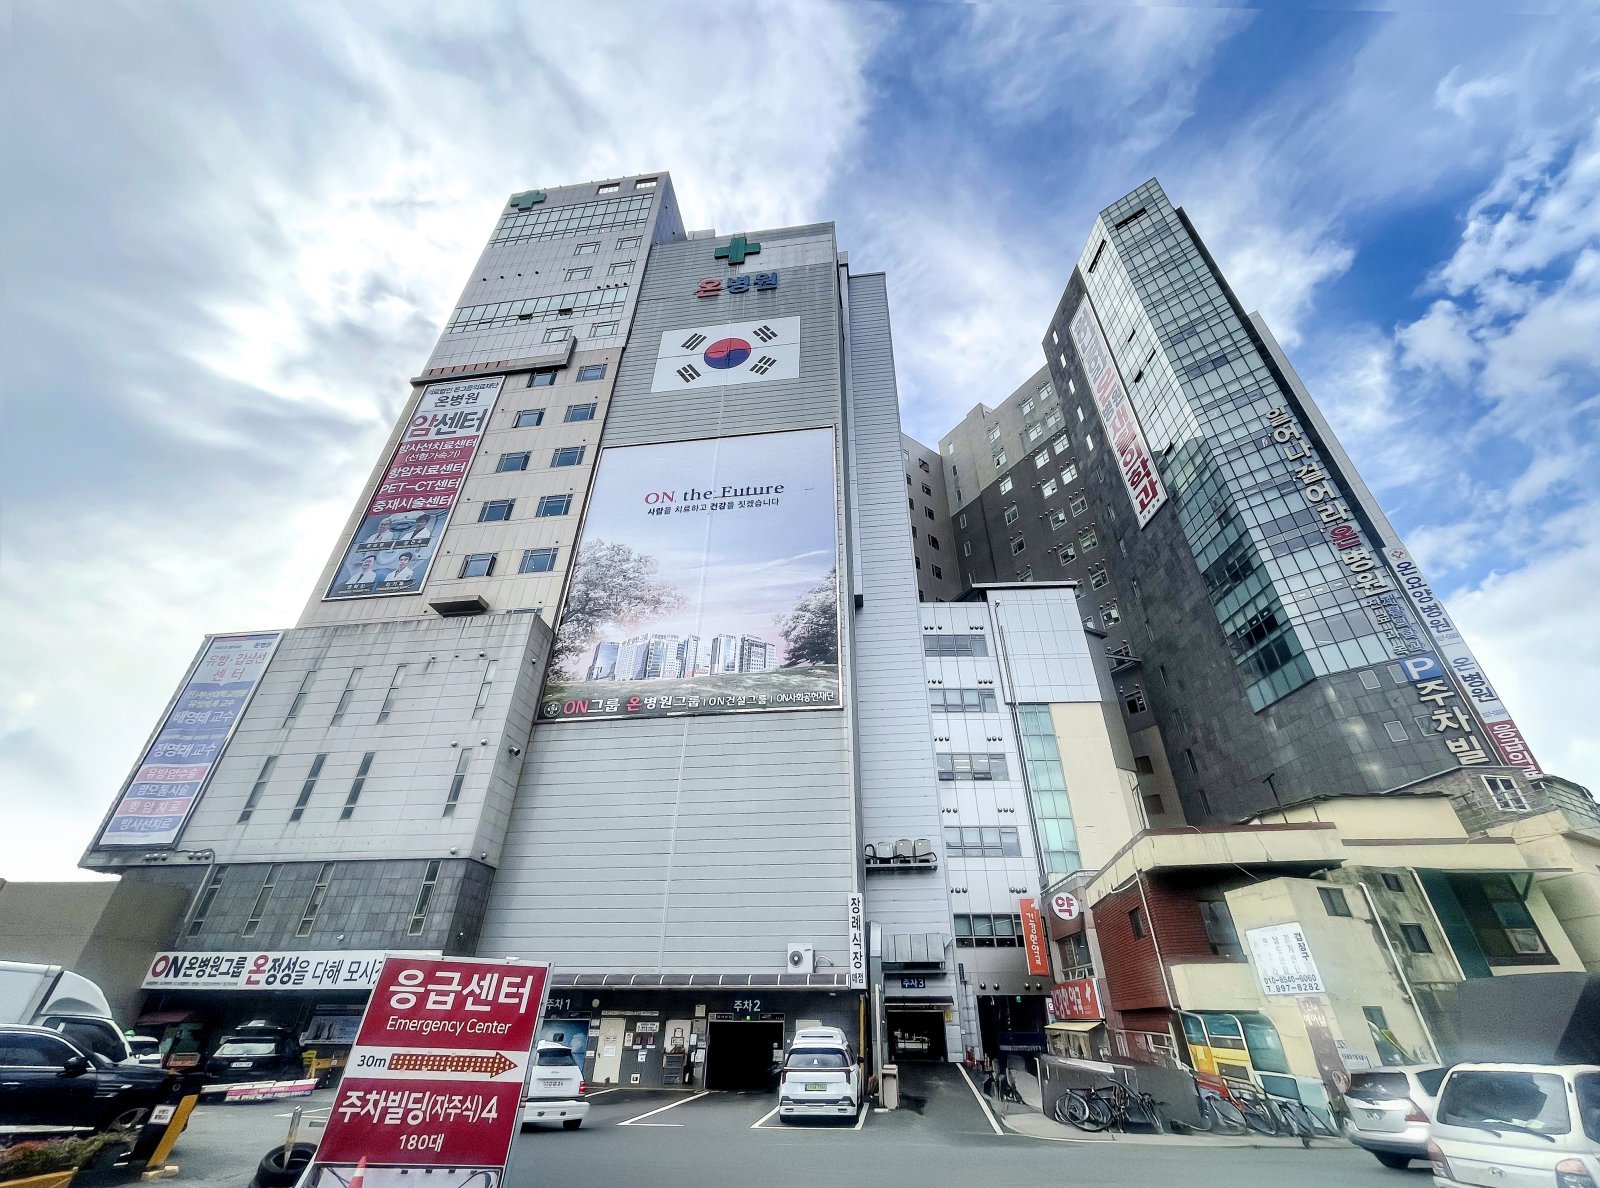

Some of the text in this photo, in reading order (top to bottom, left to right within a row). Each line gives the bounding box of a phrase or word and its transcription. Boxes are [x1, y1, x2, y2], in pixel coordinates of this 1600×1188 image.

[694, 272, 778, 298] 온병원
[434, 392, 480, 408] 온병원
[408, 408, 489, 438] 암센터
[399, 438, 478, 454] 방사선치료센터
[389, 462, 466, 479] 항암치료센터
[379, 478, 461, 494] PET-CT센터
[683, 488, 713, 502] the
[721, 484, 785, 498] Future
[372, 495, 453, 512] 중재시술센터
[647, 498, 779, 516] 사람을 치료하고 건강을 짓겠습니다
[1329, 524, 1394, 598] 온병원
[1396, 561, 1454, 635] 온요양병원
[206, 655, 229, 667] 유방
[1404, 657, 1436, 680] P
[1452, 657, 1501, 703] 온병원
[563, 699, 620, 714] ON그룹
[708, 694, 767, 706] ON건설그룹
[776, 690, 834, 703] ON사회공헌재단
[173, 710, 235, 725] 배영태 교수
[191, 743, 217, 757] 교수
[121, 817, 173, 831] 방사선치료
[1054, 896, 1075, 918] 약
[850, 897, 863, 969] 장례식장
[244, 954, 310, 986] 온정성을
[311, 959, 344, 985] 다해
[389, 969, 533, 1014] 응급센터
[386, 1016, 512, 1036] Emergency Center
[357, 1054, 387, 1068] 30m
[338, 1090, 498, 1126] 주차빌딩(자주식)4
[400, 1133, 444, 1152] 180대
